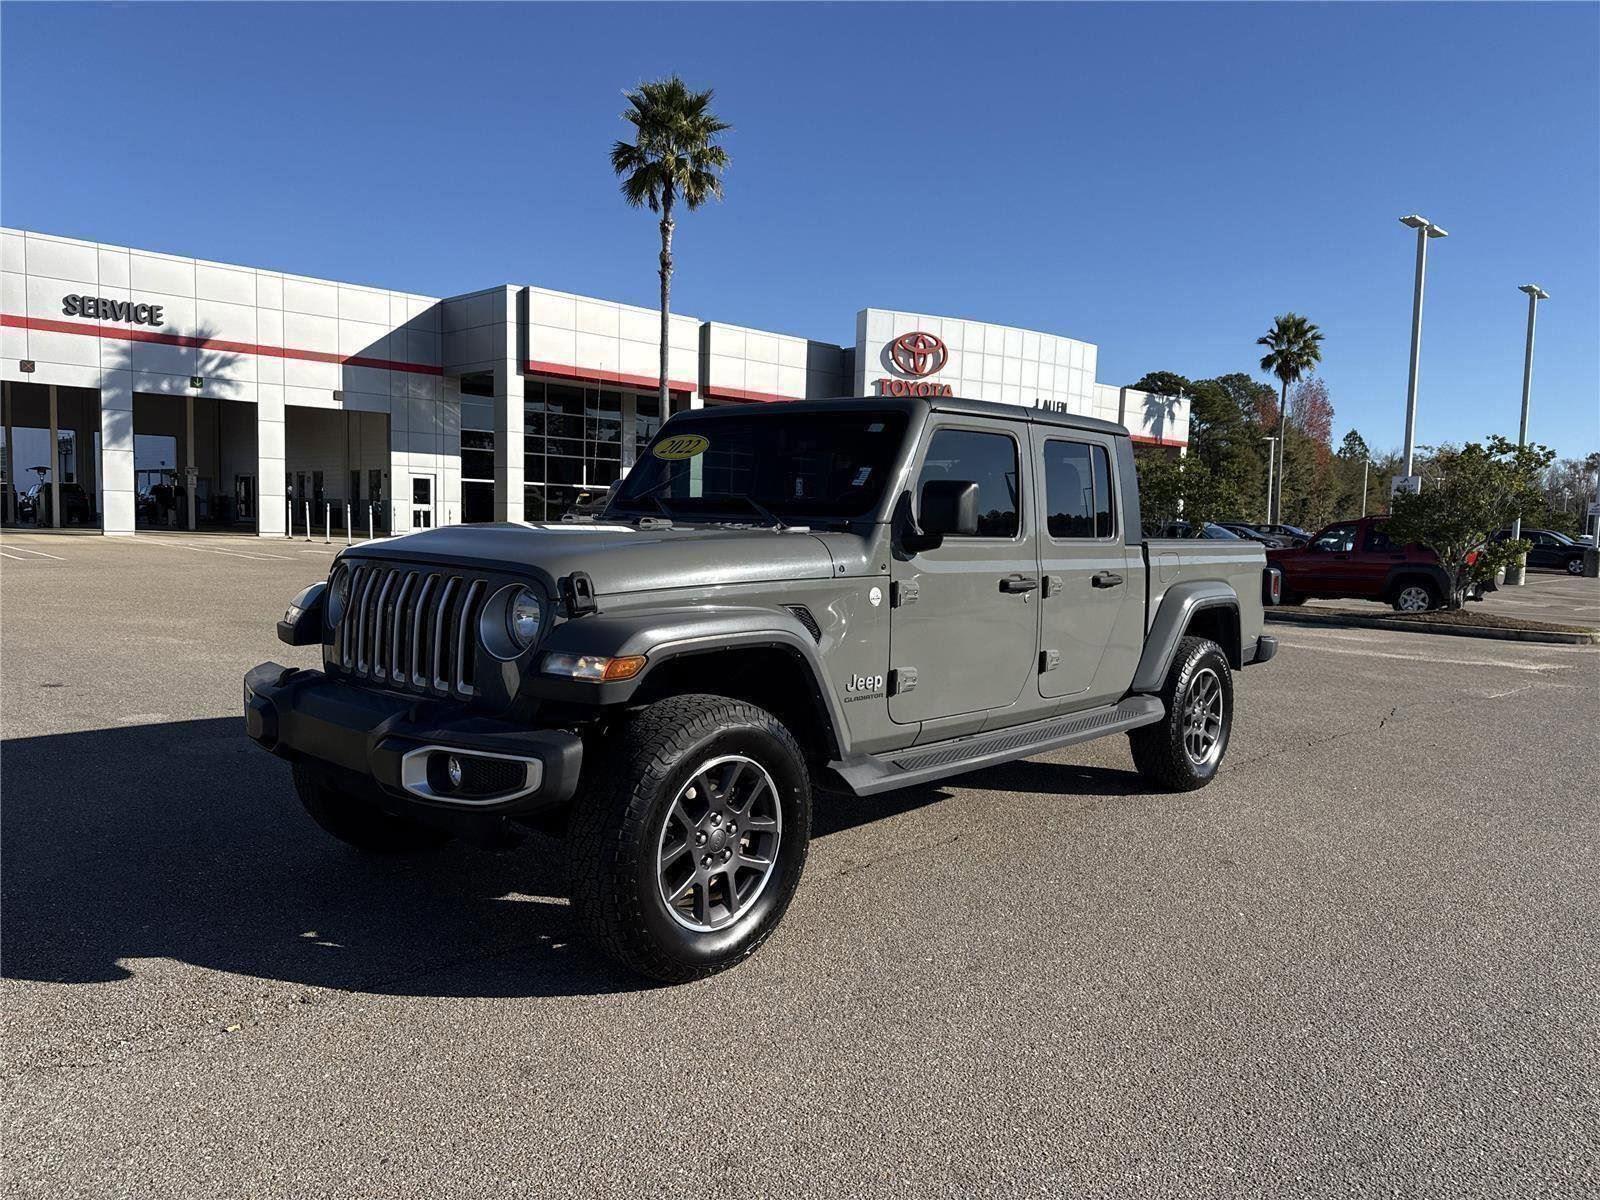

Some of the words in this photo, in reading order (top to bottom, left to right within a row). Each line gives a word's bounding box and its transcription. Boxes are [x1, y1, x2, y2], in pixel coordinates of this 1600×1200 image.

[62, 294, 164, 327] SERVICE
[879, 378, 954, 397] TOYOTA
[658, 440, 702, 454] 2022
[846, 673, 883, 692] Jeep
[844, 692, 884, 703] GLADIATOR
